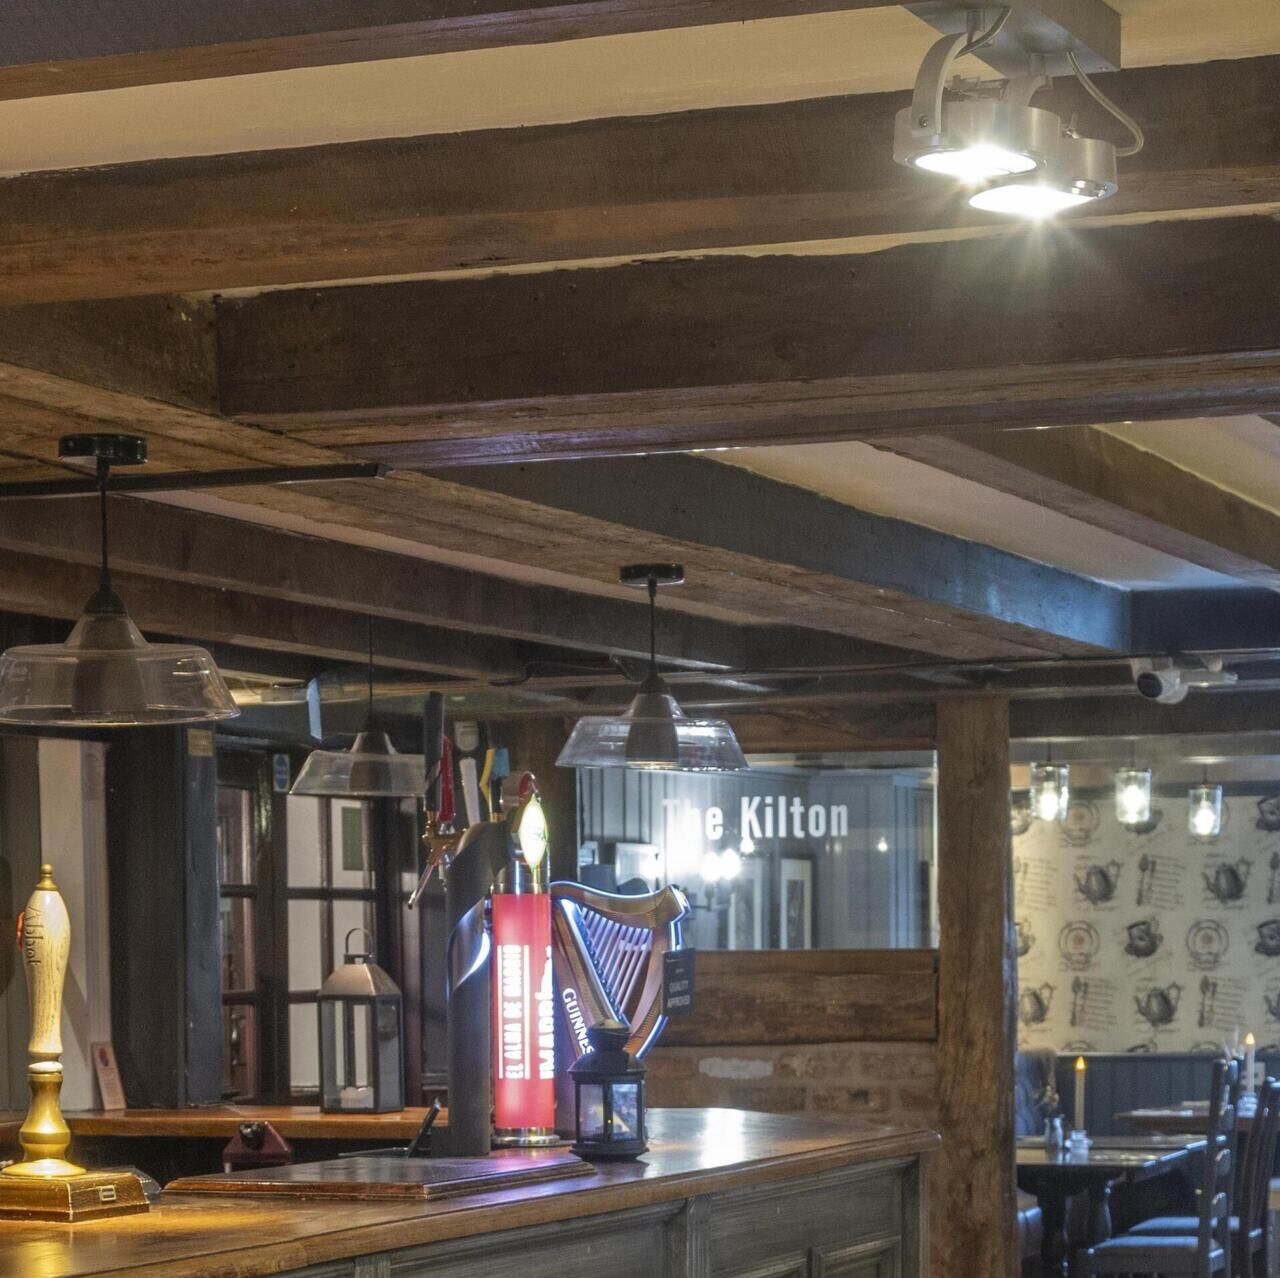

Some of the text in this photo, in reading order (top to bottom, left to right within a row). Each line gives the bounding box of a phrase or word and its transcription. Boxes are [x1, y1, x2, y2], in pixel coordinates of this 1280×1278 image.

[740, 795, 849, 839] Kilton
[25, 906, 45, 966] Abbot
[503, 1001, 523, 1019] DE
[562, 986, 595, 1055] GUINNES
[504, 1023, 523, 1060] ALMA
[505, 1063, 524, 1079] EL
